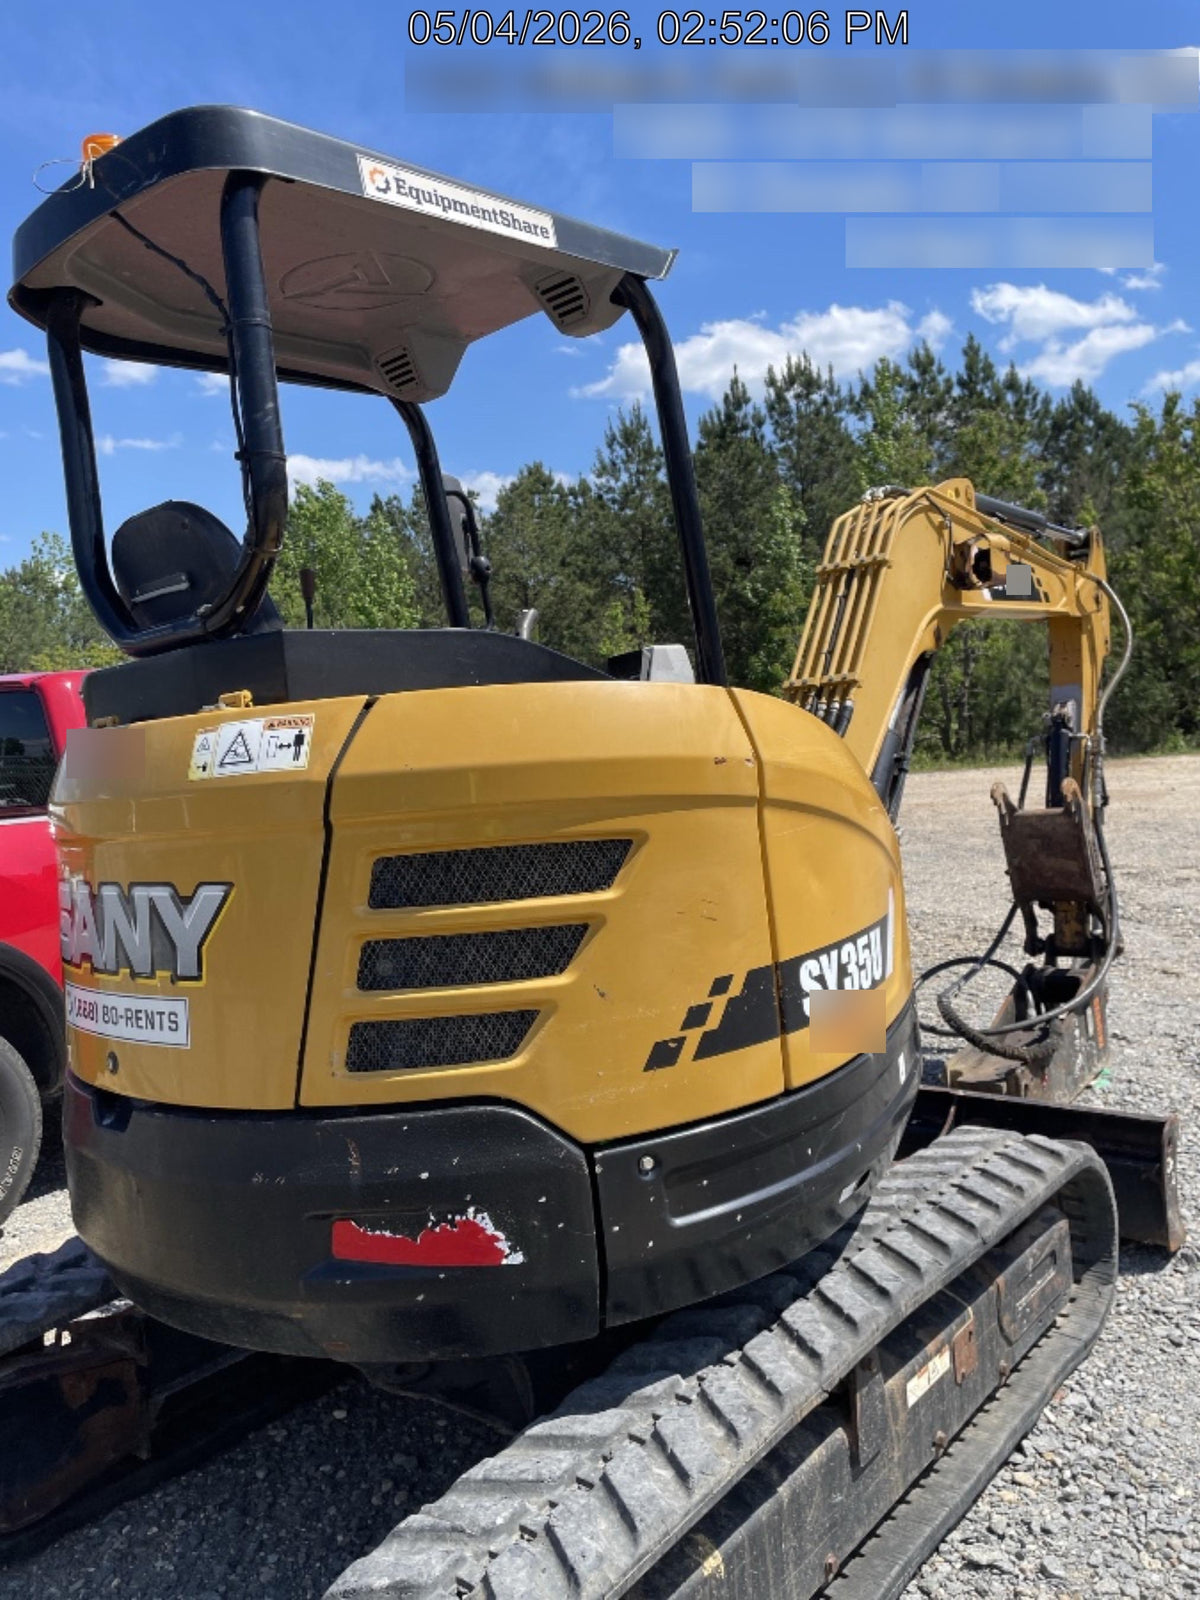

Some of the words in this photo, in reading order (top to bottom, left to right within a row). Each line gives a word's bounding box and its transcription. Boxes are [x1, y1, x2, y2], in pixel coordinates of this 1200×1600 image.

[393, 176, 550, 240] EquipmentShare
[59, 881, 235, 983] SANY
[102, 1004, 179, 1032] 80-RENTS
